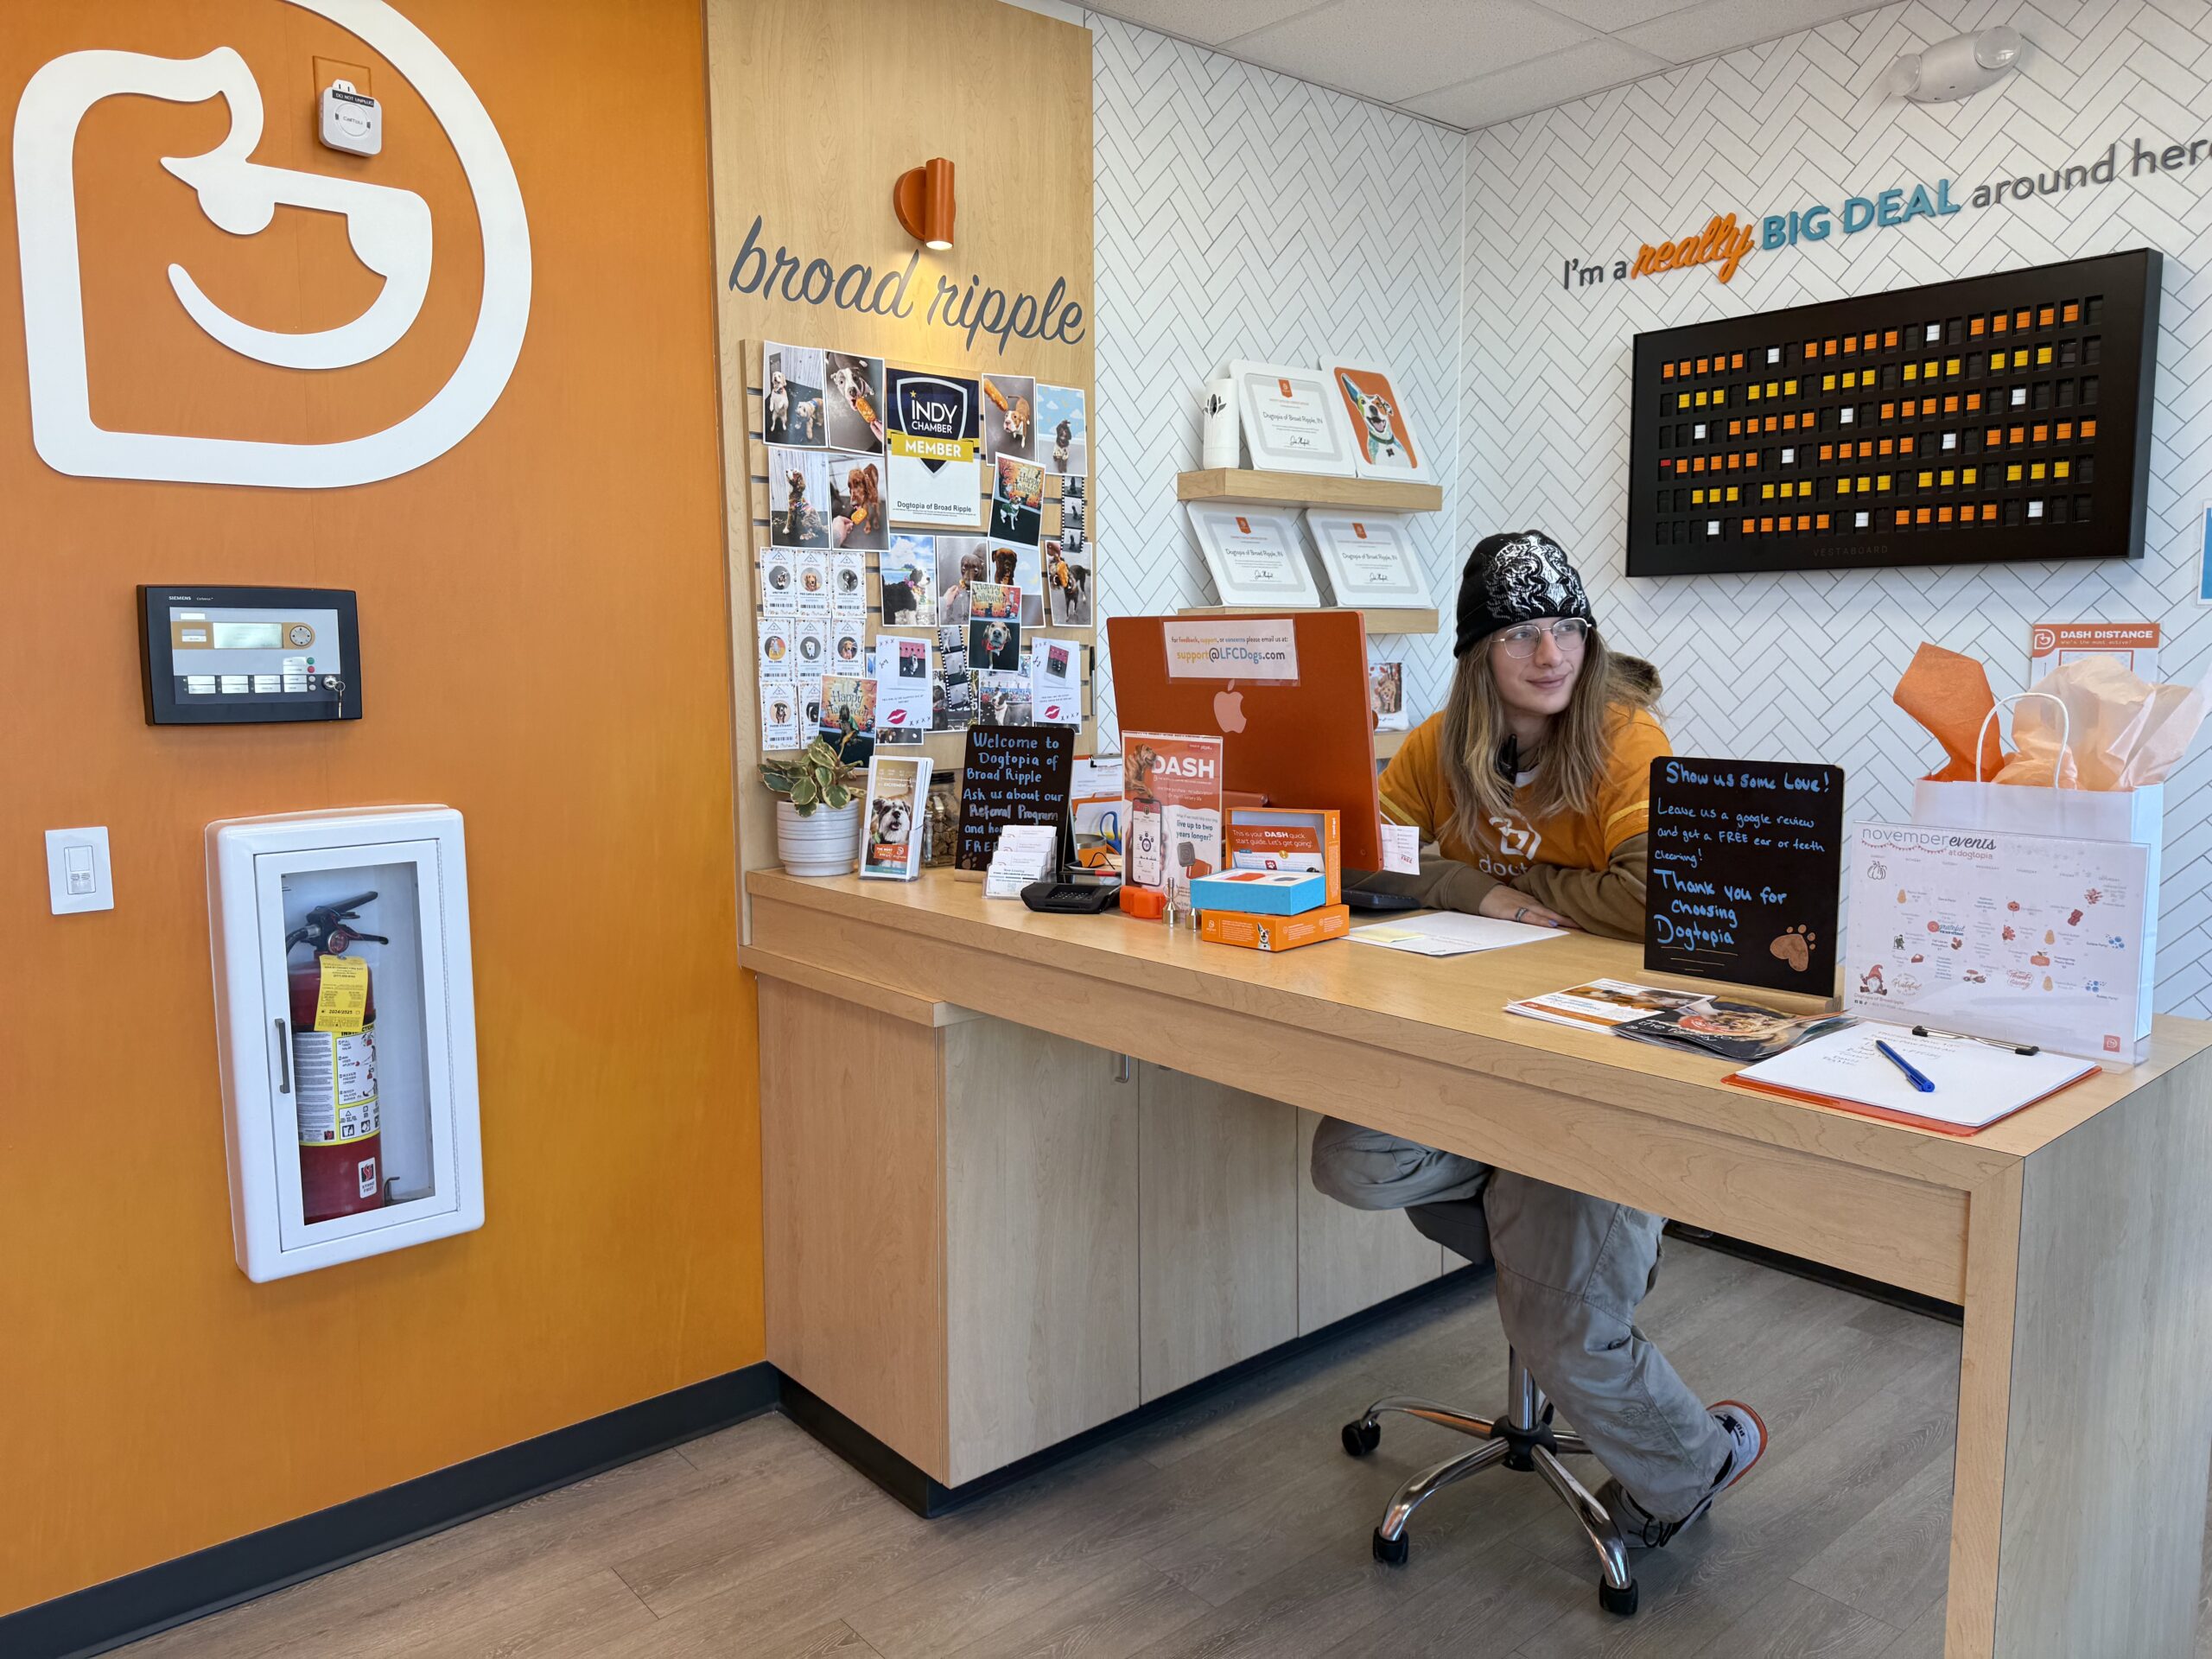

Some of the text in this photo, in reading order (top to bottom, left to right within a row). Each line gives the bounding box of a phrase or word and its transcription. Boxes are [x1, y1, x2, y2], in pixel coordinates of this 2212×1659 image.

[1564, 137, 2212, 289] I'm a really BIG DEAL around her
[728, 215, 1085, 356] broad ripple
[911, 399, 957, 424] INDY
[912, 421, 952, 434] CHAMBER
[905, 439, 962, 458] MEMBER
[897, 500, 925, 511] Dogtopia
[934, 503, 951, 512] Broad
[953, 504, 972, 513] Ripple
[1813, 545, 1888, 556] VESTABOARD
[2061, 630, 2153, 639] DASH DISTANCE
[1177, 647, 1286, 664] support@LFCDogs.com
[973, 732, 1059, 749] Welcome to
[978, 752, 1058, 771] Dogtopia of
[1152, 755, 1215, 779] DASH
[967, 767, 1042, 785] Broad Ripple
[1666, 760, 1708, 784] Show
[1714, 773, 1734, 787] us
[963, 788, 1064, 802] Ask us about our
[1018, 804, 1058, 826] Program
[1657, 798, 1696, 817] Leave
[1700, 808, 1716, 818] us
[1721, 811, 1729, 820] a
[1777, 816, 1815, 828] review
[965, 823, 984, 834] and
[1657, 826, 1677, 837] and
[1682, 829, 1700, 842] get
[1719, 830, 1748, 843] FREE
[1754, 837, 1772, 846] ear
[1777, 840, 1789, 849] or
[1793, 838, 1825, 852] teeth
[1862, 828, 1997, 850] november events
[1957, 850, 1993, 860] dogtopia
[1653, 868, 1788, 905] Thank you for
[1653, 914, 1735, 950] Dogtopia
